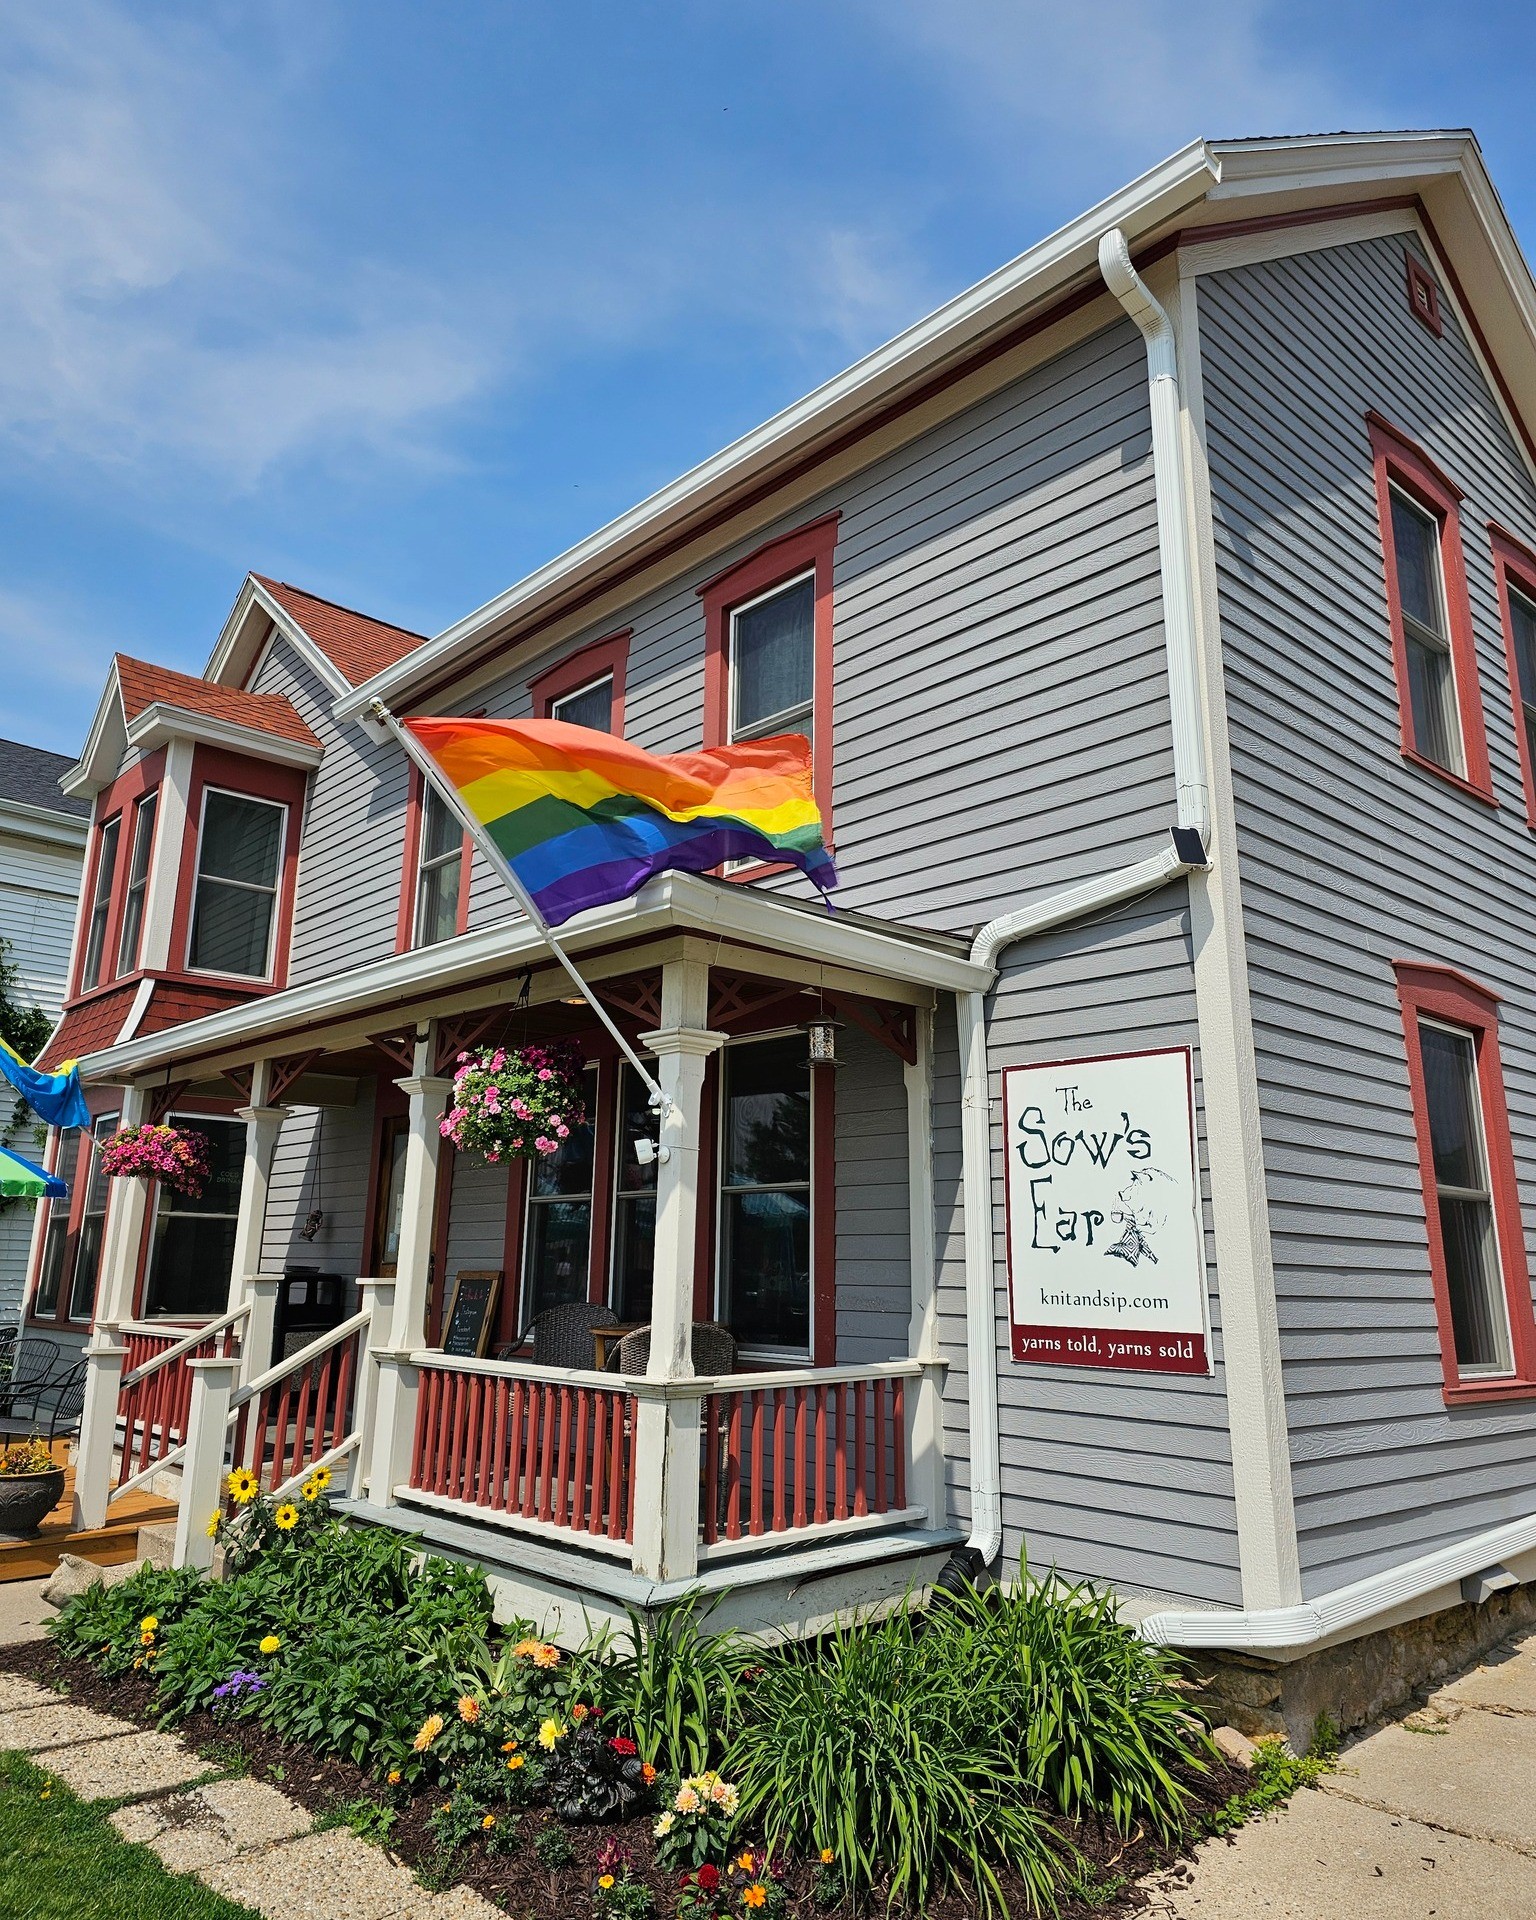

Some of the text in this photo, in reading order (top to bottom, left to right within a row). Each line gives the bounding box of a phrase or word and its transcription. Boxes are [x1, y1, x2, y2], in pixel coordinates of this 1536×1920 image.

[1055, 1085, 1093, 1115] The
[1016, 1106, 1152, 1169] Sow's
[1030, 1174, 1105, 1254] Ear
[1040, 1287, 1169, 1313] knitandsip.com
[1022, 1335, 1193, 1360] yarns told, yarns sold
